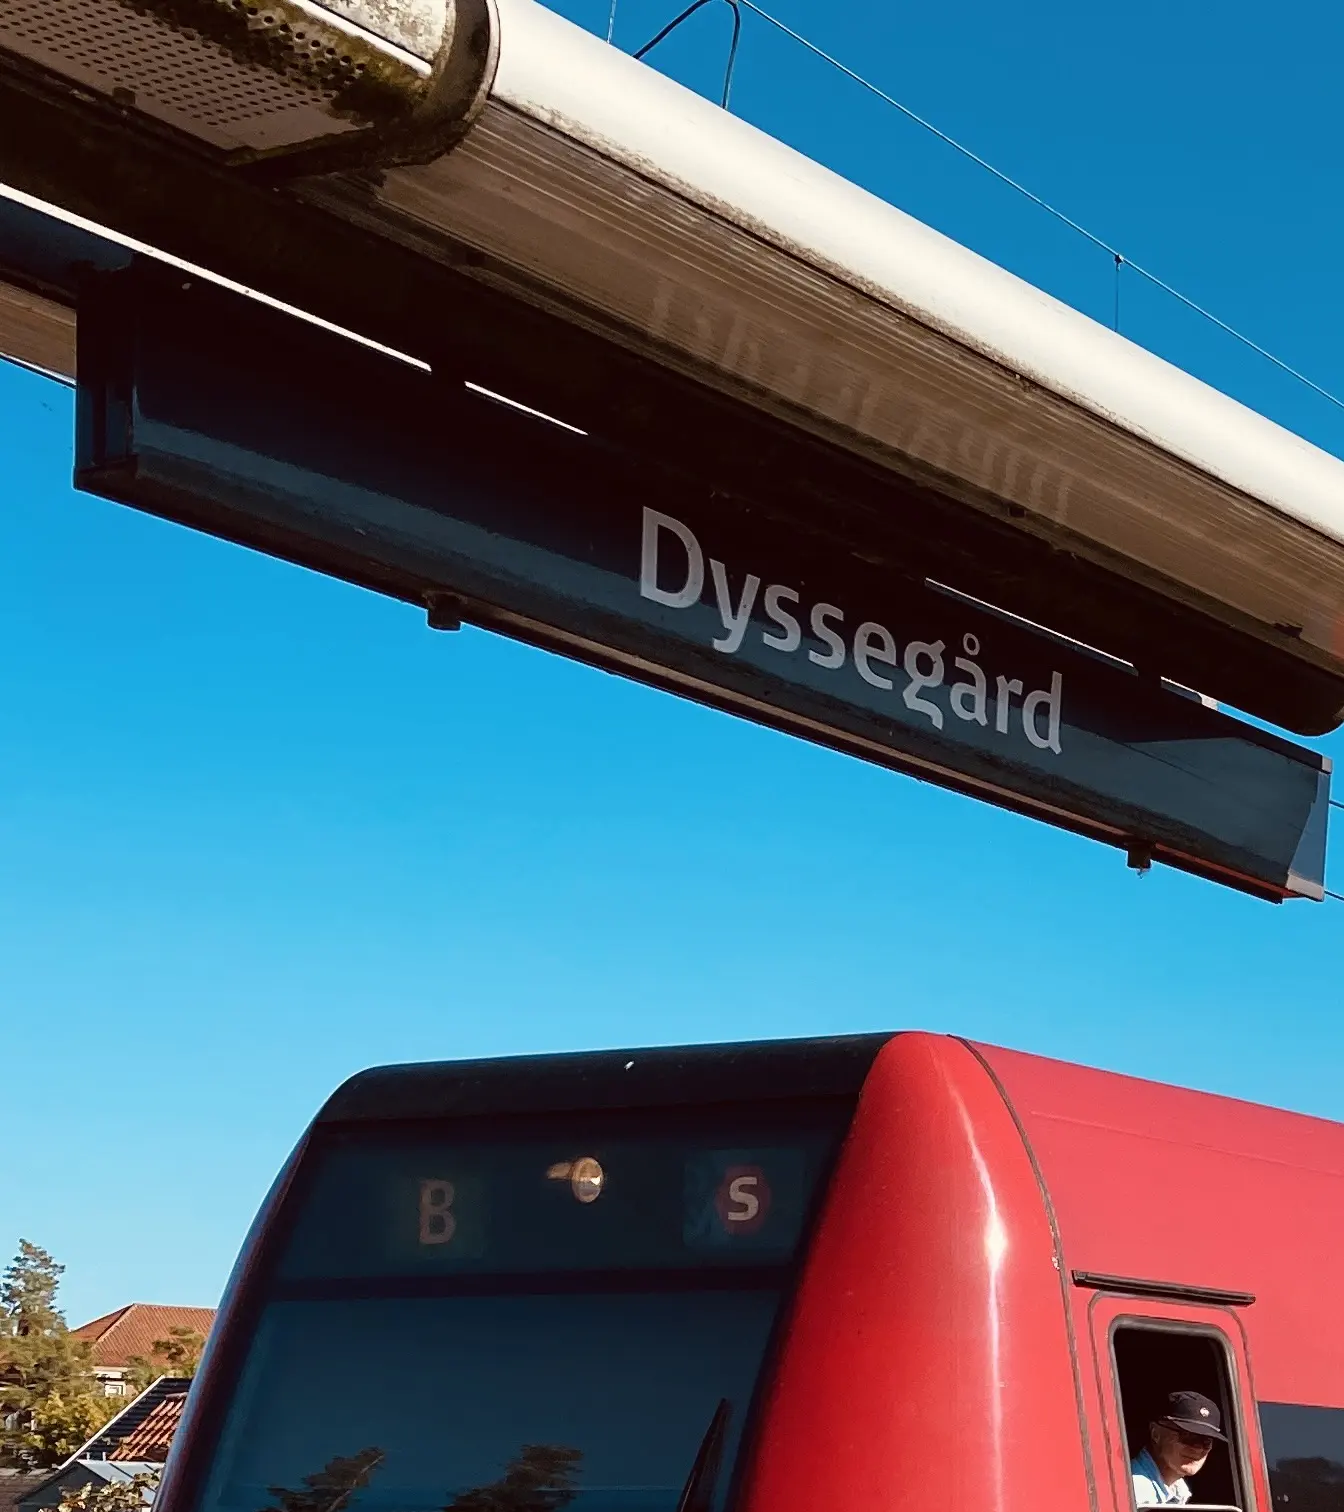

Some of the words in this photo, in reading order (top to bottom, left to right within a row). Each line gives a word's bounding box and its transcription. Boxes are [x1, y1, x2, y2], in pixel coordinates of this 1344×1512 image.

[640, 506, 1062, 755] Dyssegård
[419, 1179, 456, 1245] B
[727, 1176, 759, 1221] S
